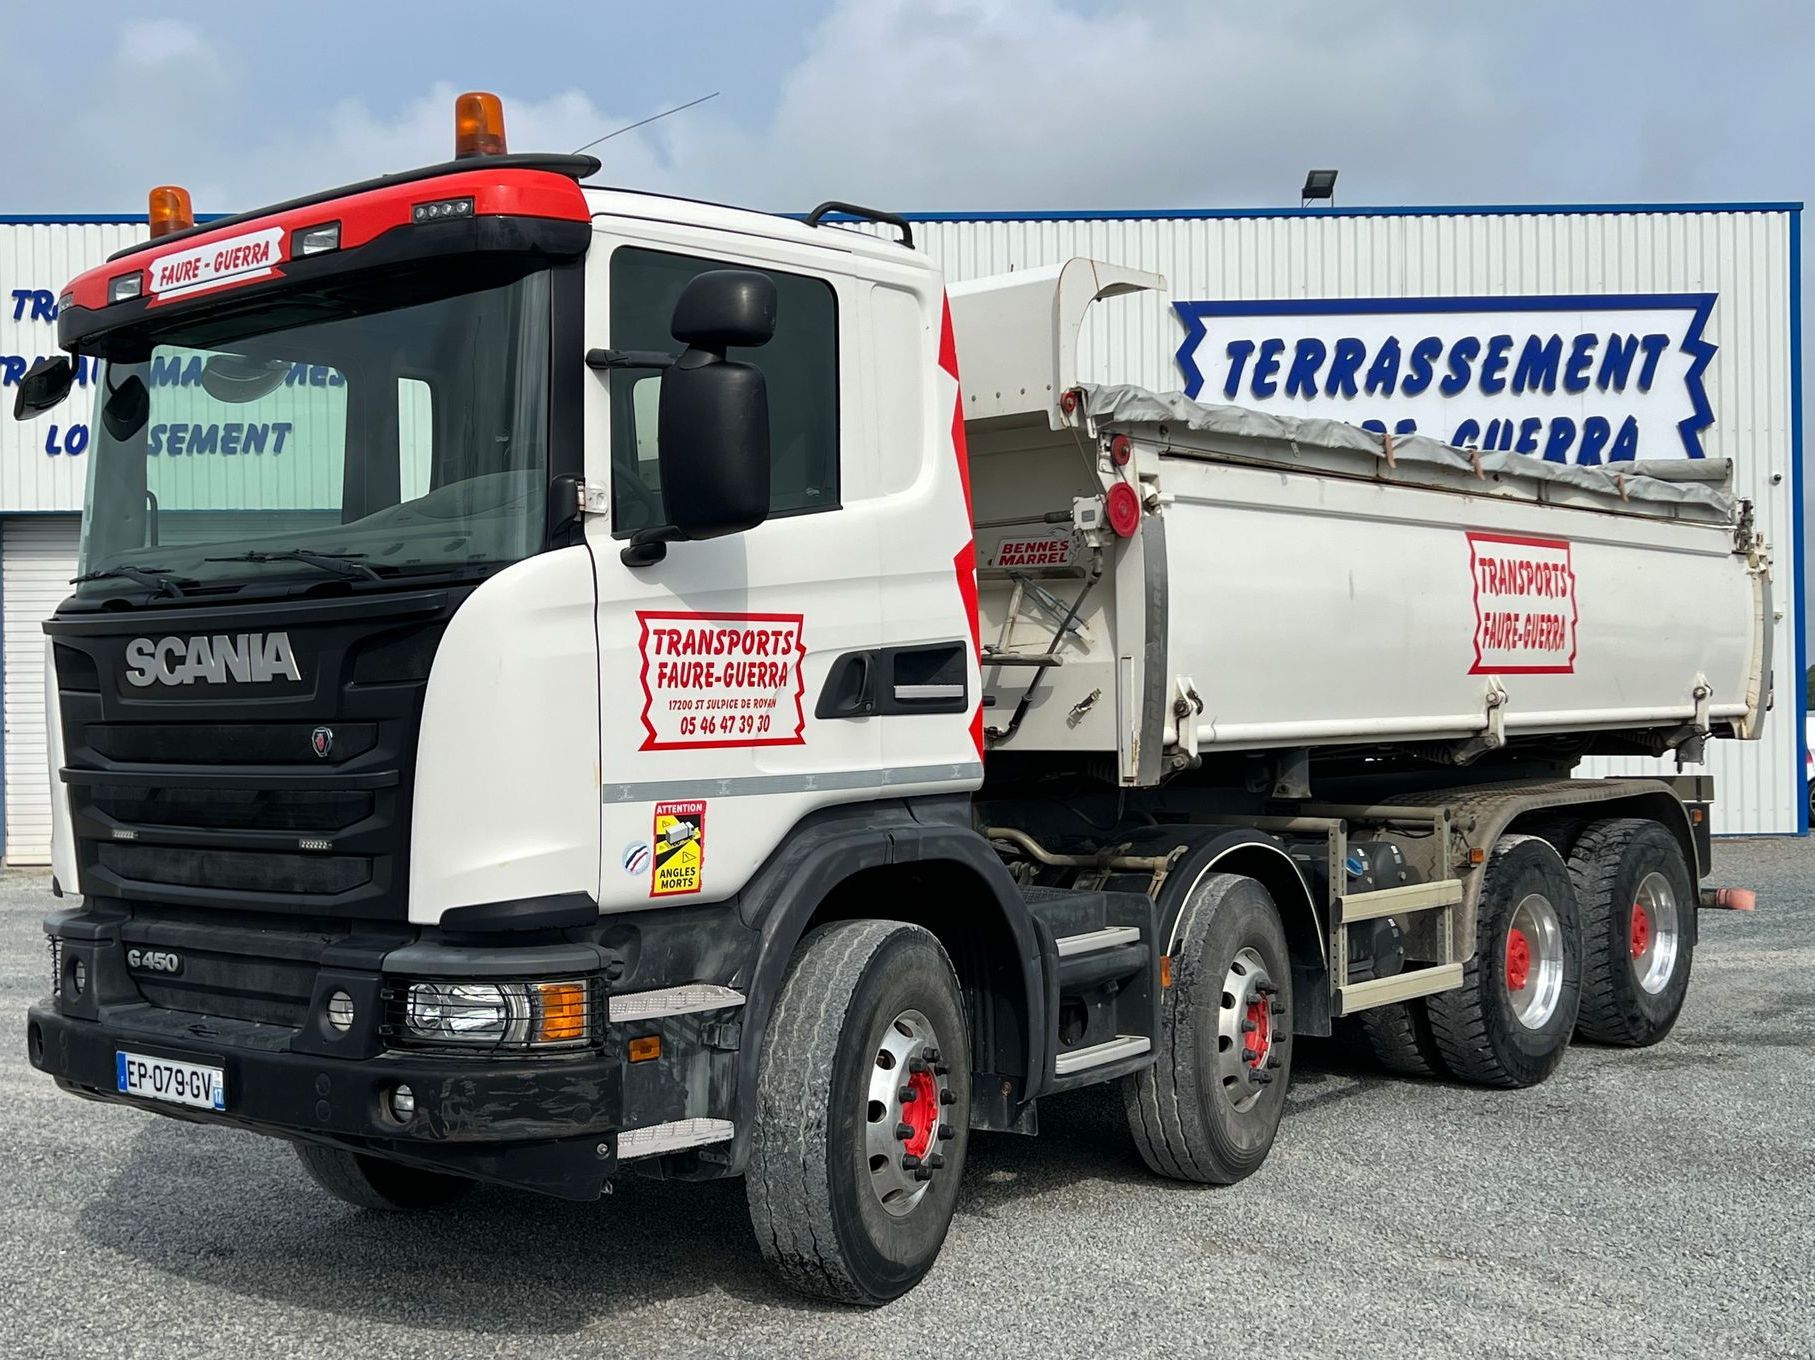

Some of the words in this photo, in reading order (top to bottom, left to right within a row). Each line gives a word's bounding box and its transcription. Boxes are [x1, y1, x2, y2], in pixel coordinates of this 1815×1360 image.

[160, 257, 200, 287] FAURE
[214, 240, 270, 271] GUERRA
[1223, 333, 1670, 400] TERRASSEMENT
[999, 552, 1068, 566] MARREL
[1004, 540, 1069, 554] BENNES
[1478, 556, 1568, 599] TRANSPORTS
[653, 628, 794, 657] TRANSPORTS
[1482, 611, 1566, 652] FAURE-GUERRA
[125, 631, 301, 687] SCANIA
[657, 661, 788, 690] FAURE-GUERRA
[669, 700, 692, 710] 17200
[694, 700, 705, 710] ST
[706, 699, 738, 710] SULPICE
[740, 699, 751, 709] DE
[754, 699, 777, 709] ROYAN
[680, 716, 696, 735] 05
[700, 716, 716, 734] 46
[720, 715, 735, 734] 47
[739, 715, 754, 734] 39
[757, 715, 770, 733] 30
[656, 803, 703, 814] ATTENTION
[660, 867, 696, 879] ANGLES
[661, 878, 693, 889] MORTS
[127, 1060, 212, 1101] EP-079-GV
[214, 1088, 223, 1105] 17
